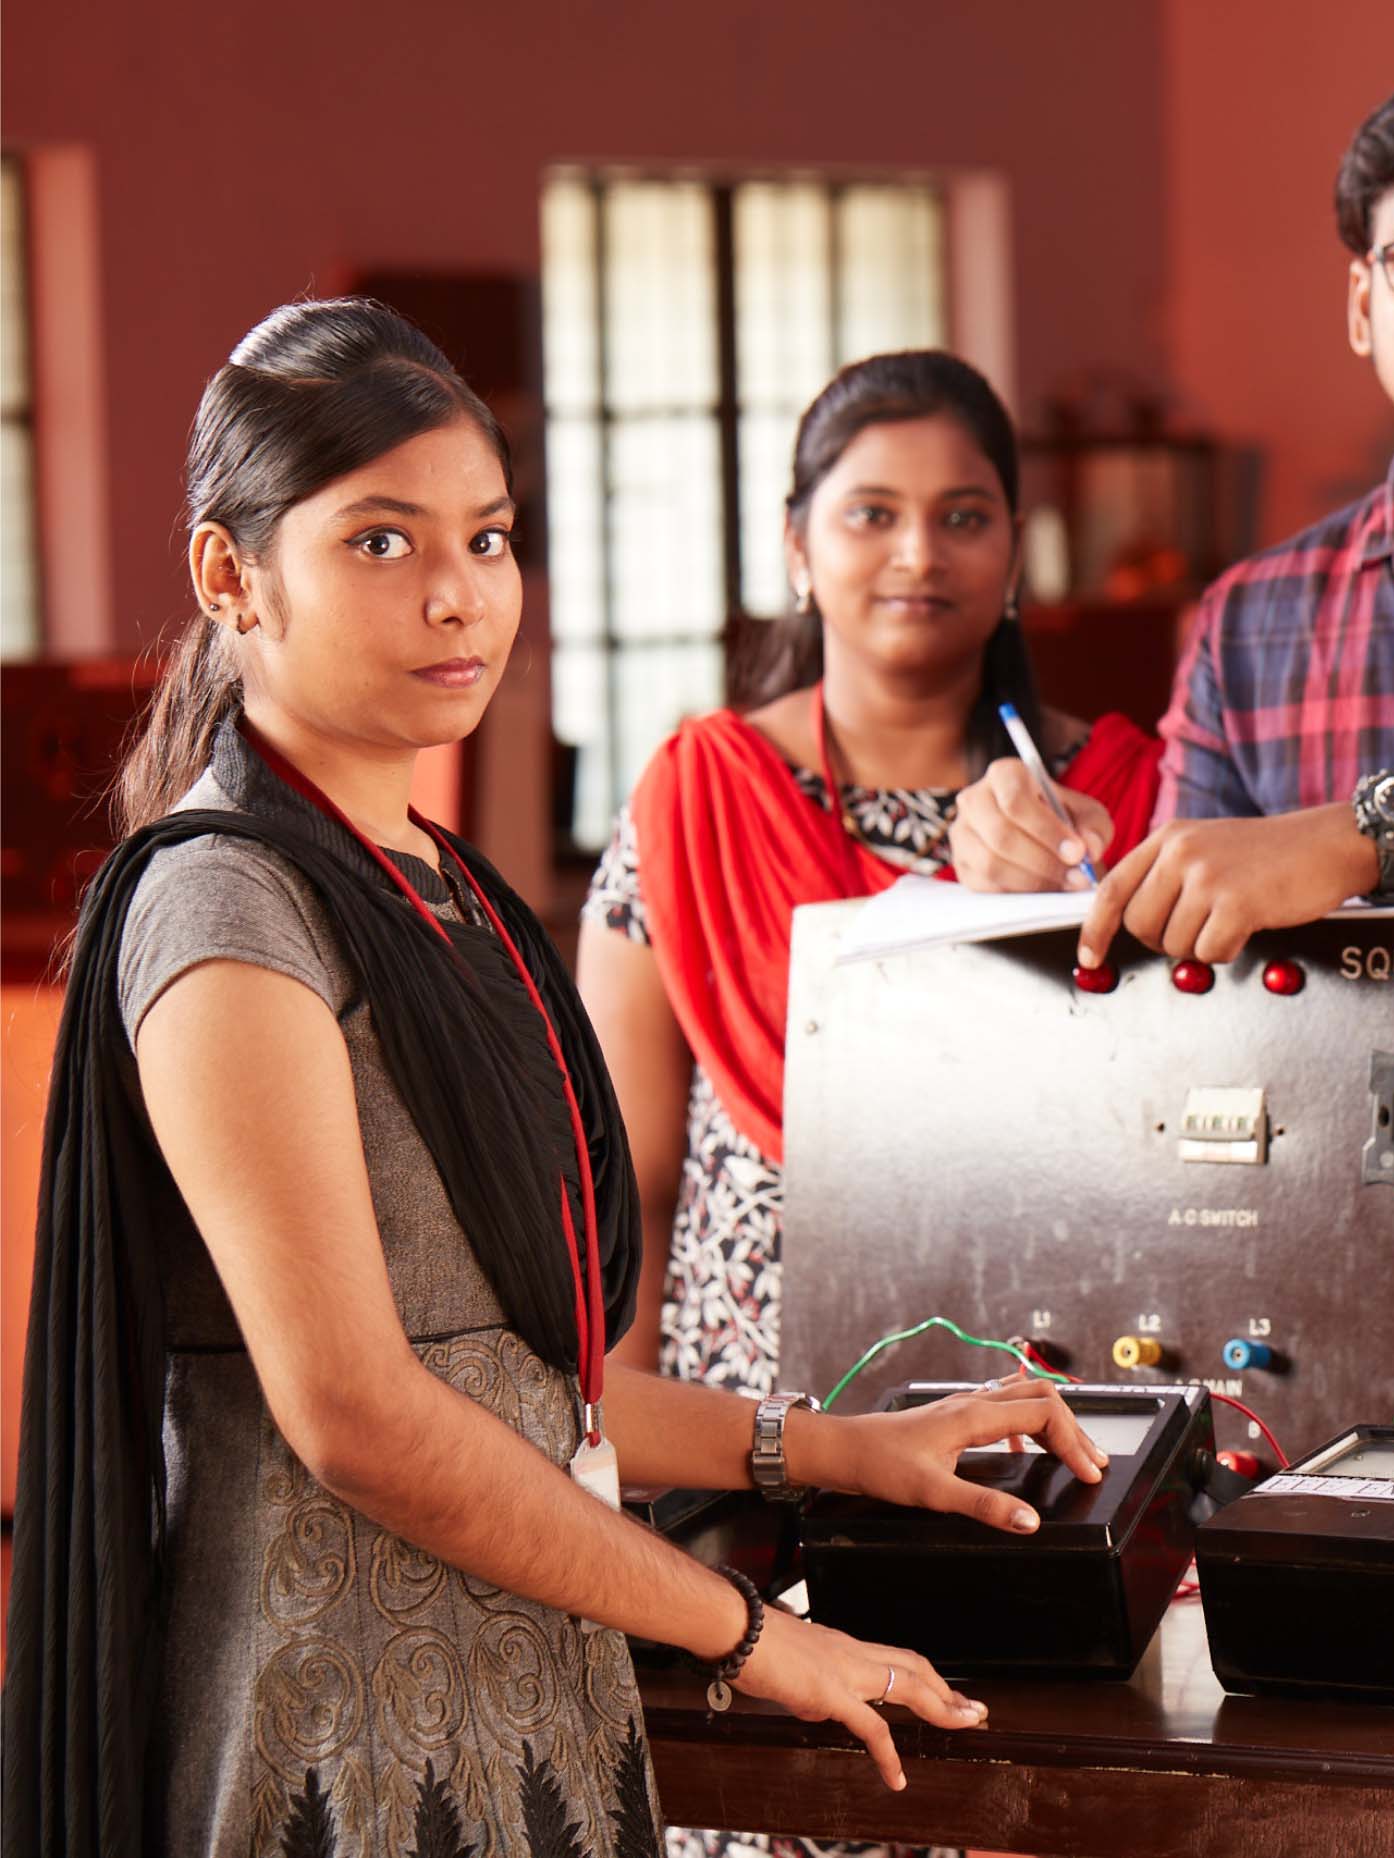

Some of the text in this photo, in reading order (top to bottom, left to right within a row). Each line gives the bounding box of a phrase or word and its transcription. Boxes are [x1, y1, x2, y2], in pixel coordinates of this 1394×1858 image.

[1199, 1208, 1258, 1227] SWITCH
[1032, 1310, 1051, 1329] L1
[1138, 1314, 1161, 1332] L2
[1249, 1317, 1271, 1336] L3
